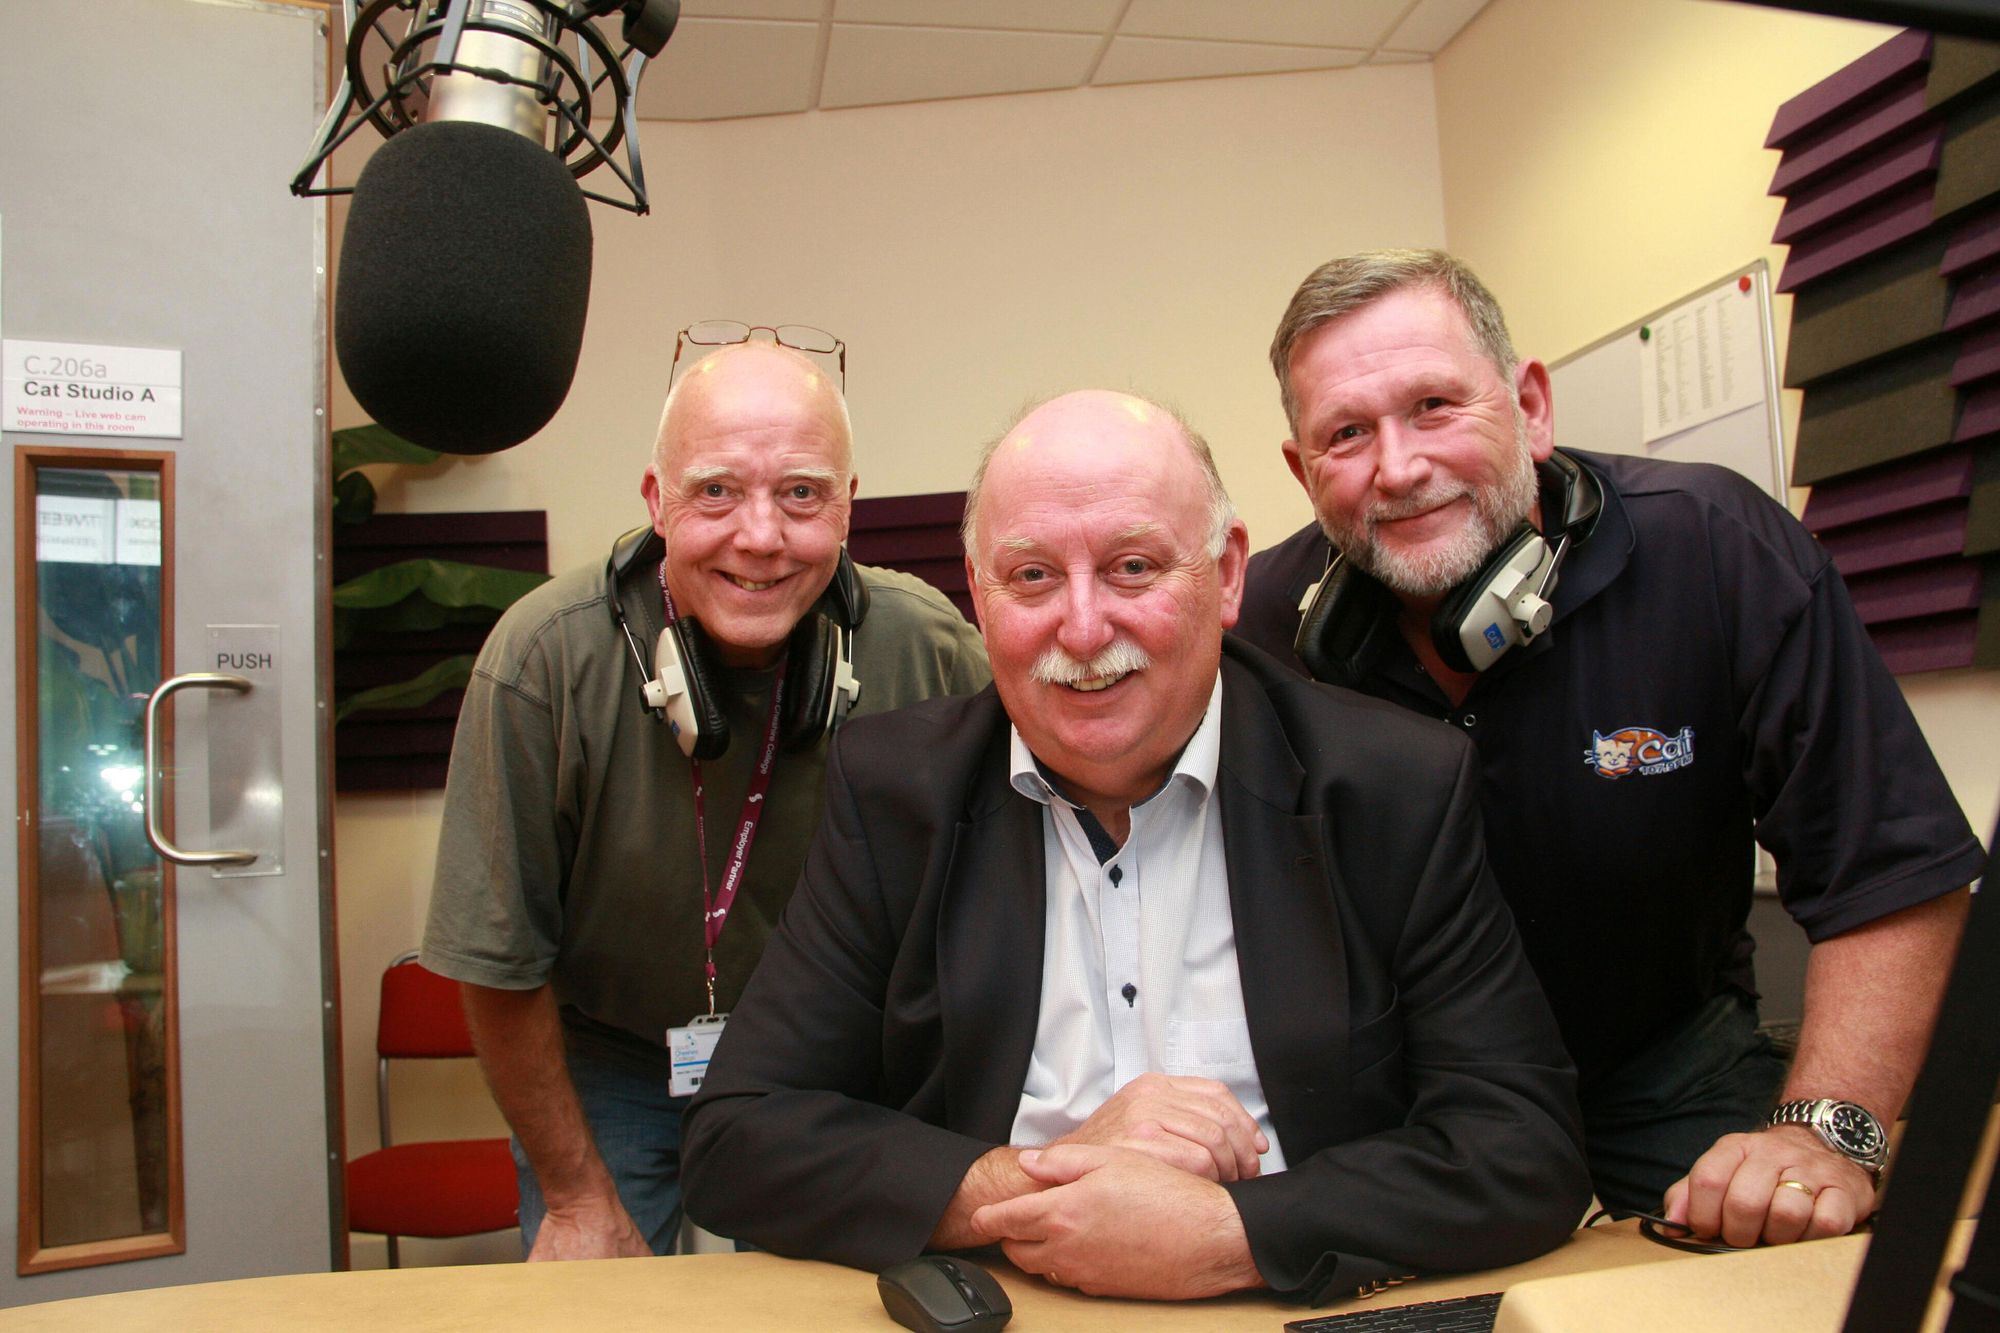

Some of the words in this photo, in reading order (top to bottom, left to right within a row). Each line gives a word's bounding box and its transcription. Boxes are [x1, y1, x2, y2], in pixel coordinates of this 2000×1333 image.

[24, 355, 107, 379] C.206a
[24, 381, 60, 397] Cat
[67, 384, 134, 401] Studio
[141, 388, 155, 402] A
[17, 406, 63, 419] Warning
[75, 410, 97, 419] Live
[100, 411, 122, 421] web
[125, 414, 146, 422] cam
[17, 418, 69, 431] operating
[72, 420, 82, 429] in
[85, 421, 104, 431] this
[107, 424, 135, 432] room
[217, 653, 272, 669] PUSH
[760, 743, 775, 775] College
[736, 820, 753, 860] Employer
[725, 861, 742, 892] Partner
